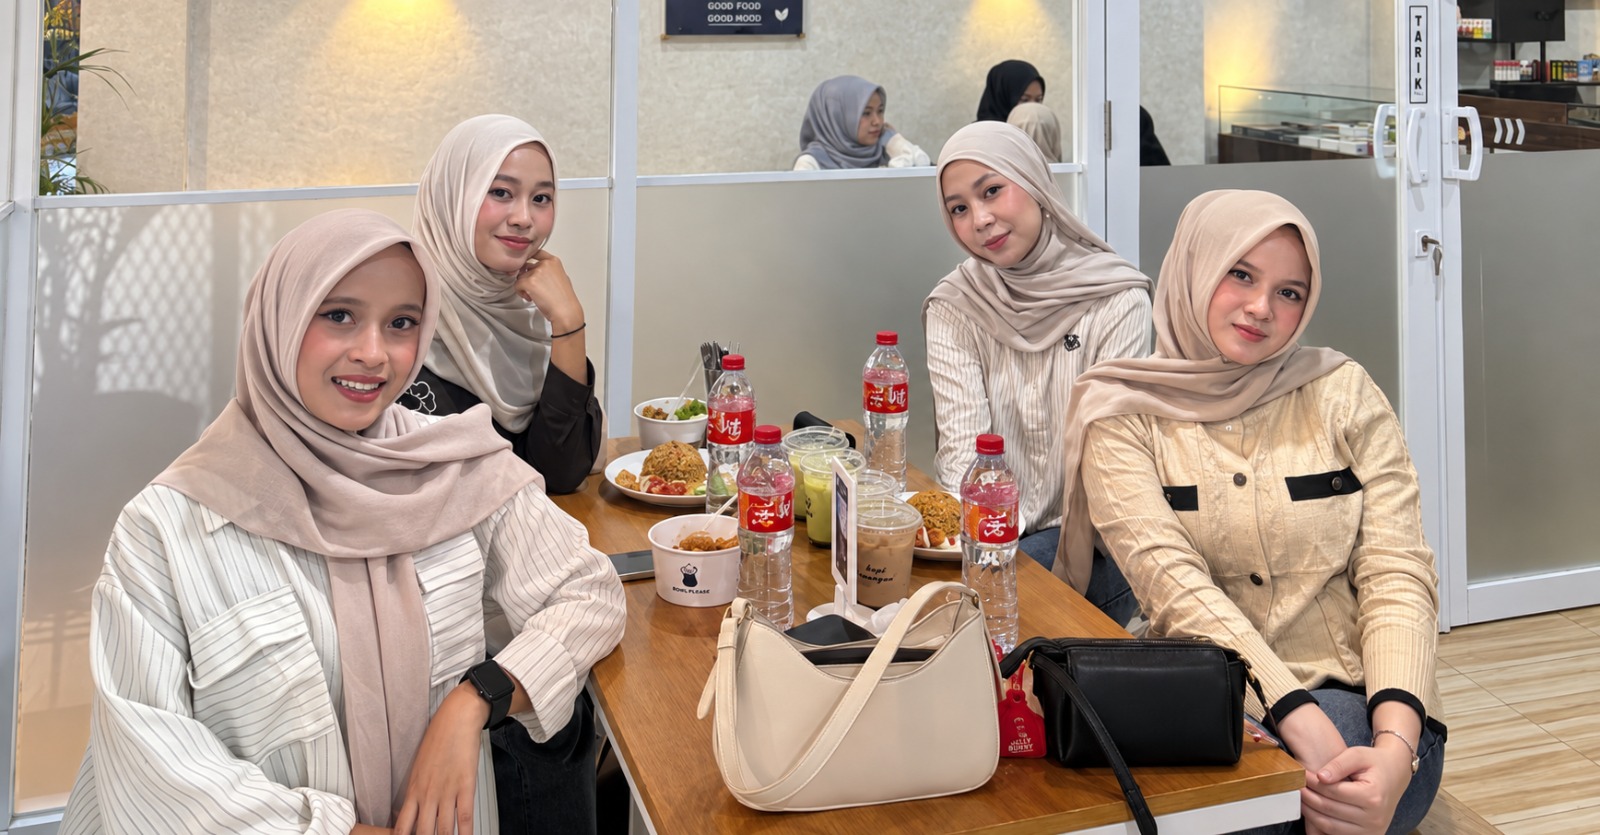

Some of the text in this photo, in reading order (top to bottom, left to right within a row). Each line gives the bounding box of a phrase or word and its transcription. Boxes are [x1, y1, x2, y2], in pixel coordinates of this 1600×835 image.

[708, 2, 761, 10] GOOD FOOD
[707, 14, 762, 22] GOOD MOOD
[1414, 15, 1422, 89] TARIK
[865, 564, 887, 575] kopi
[672, 586, 688, 594] BOWL
